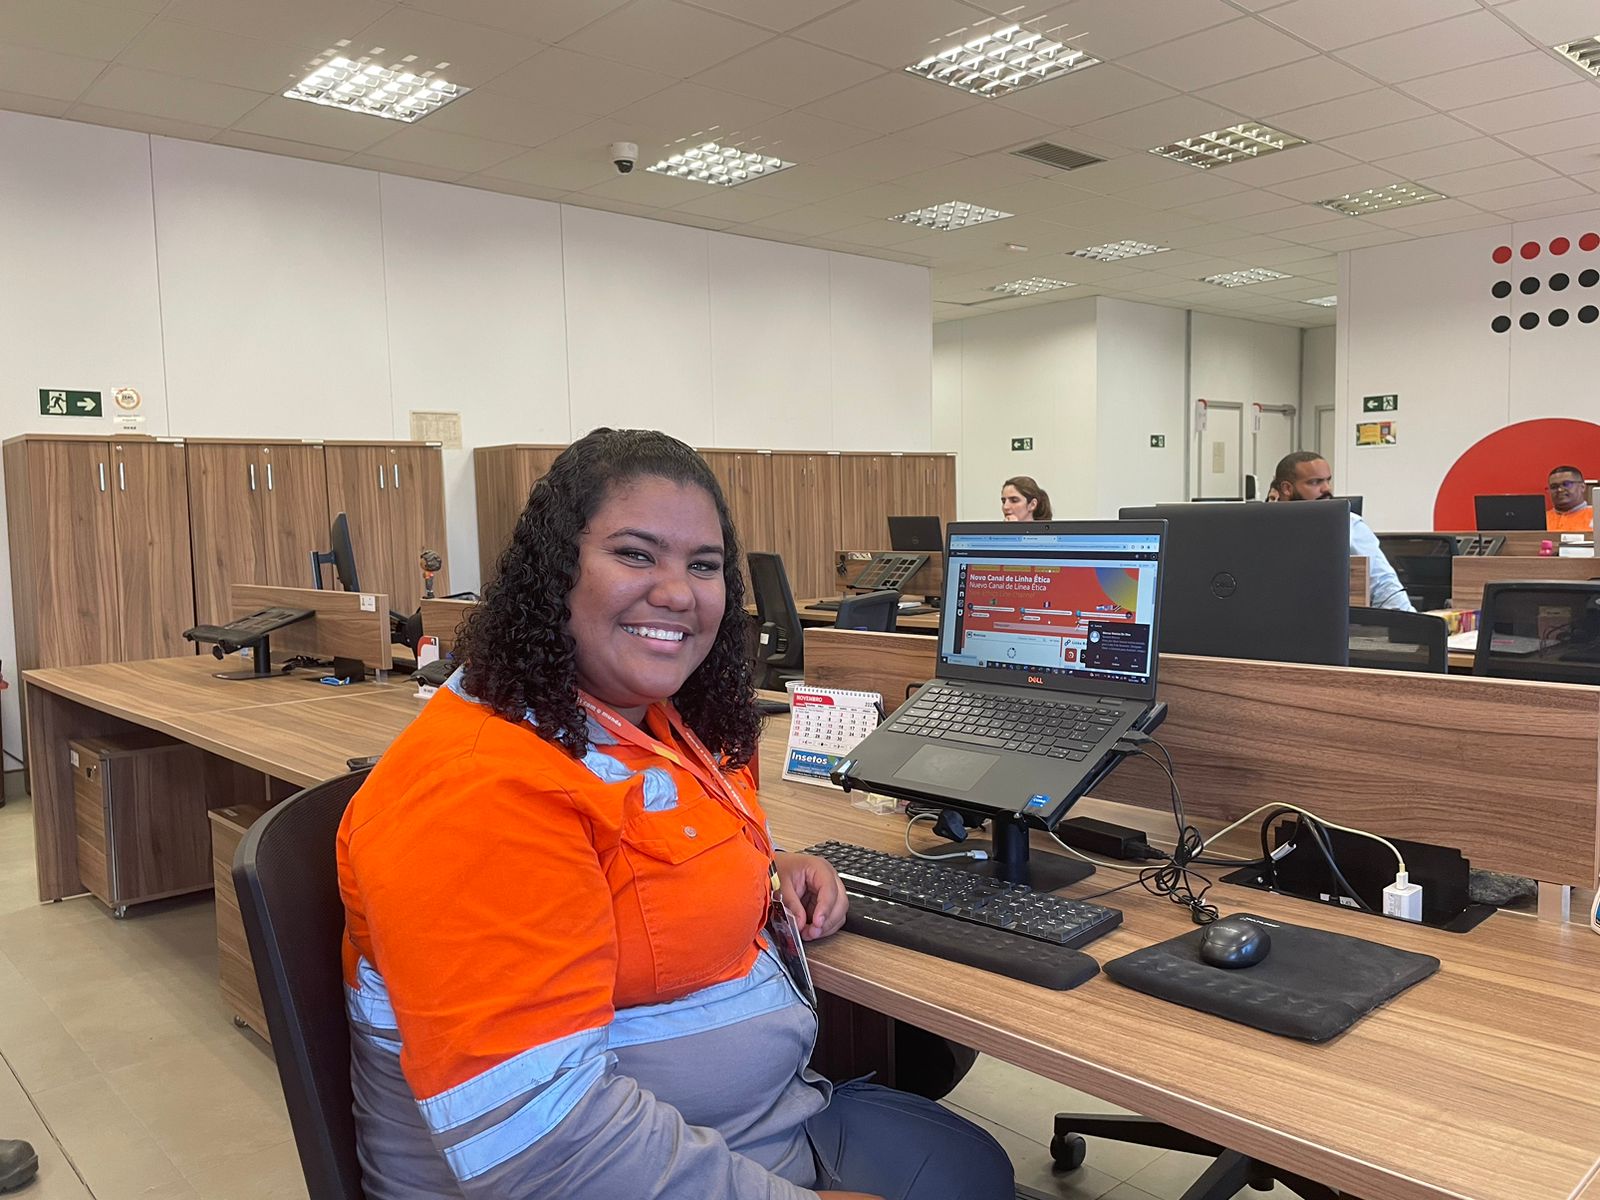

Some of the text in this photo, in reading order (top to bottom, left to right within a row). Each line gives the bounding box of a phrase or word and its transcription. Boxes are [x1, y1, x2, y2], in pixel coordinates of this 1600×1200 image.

[1034, 574, 1050, 583] Ética
[1028, 676, 1043, 684] DELL
[792, 752, 828, 764] Insetos
